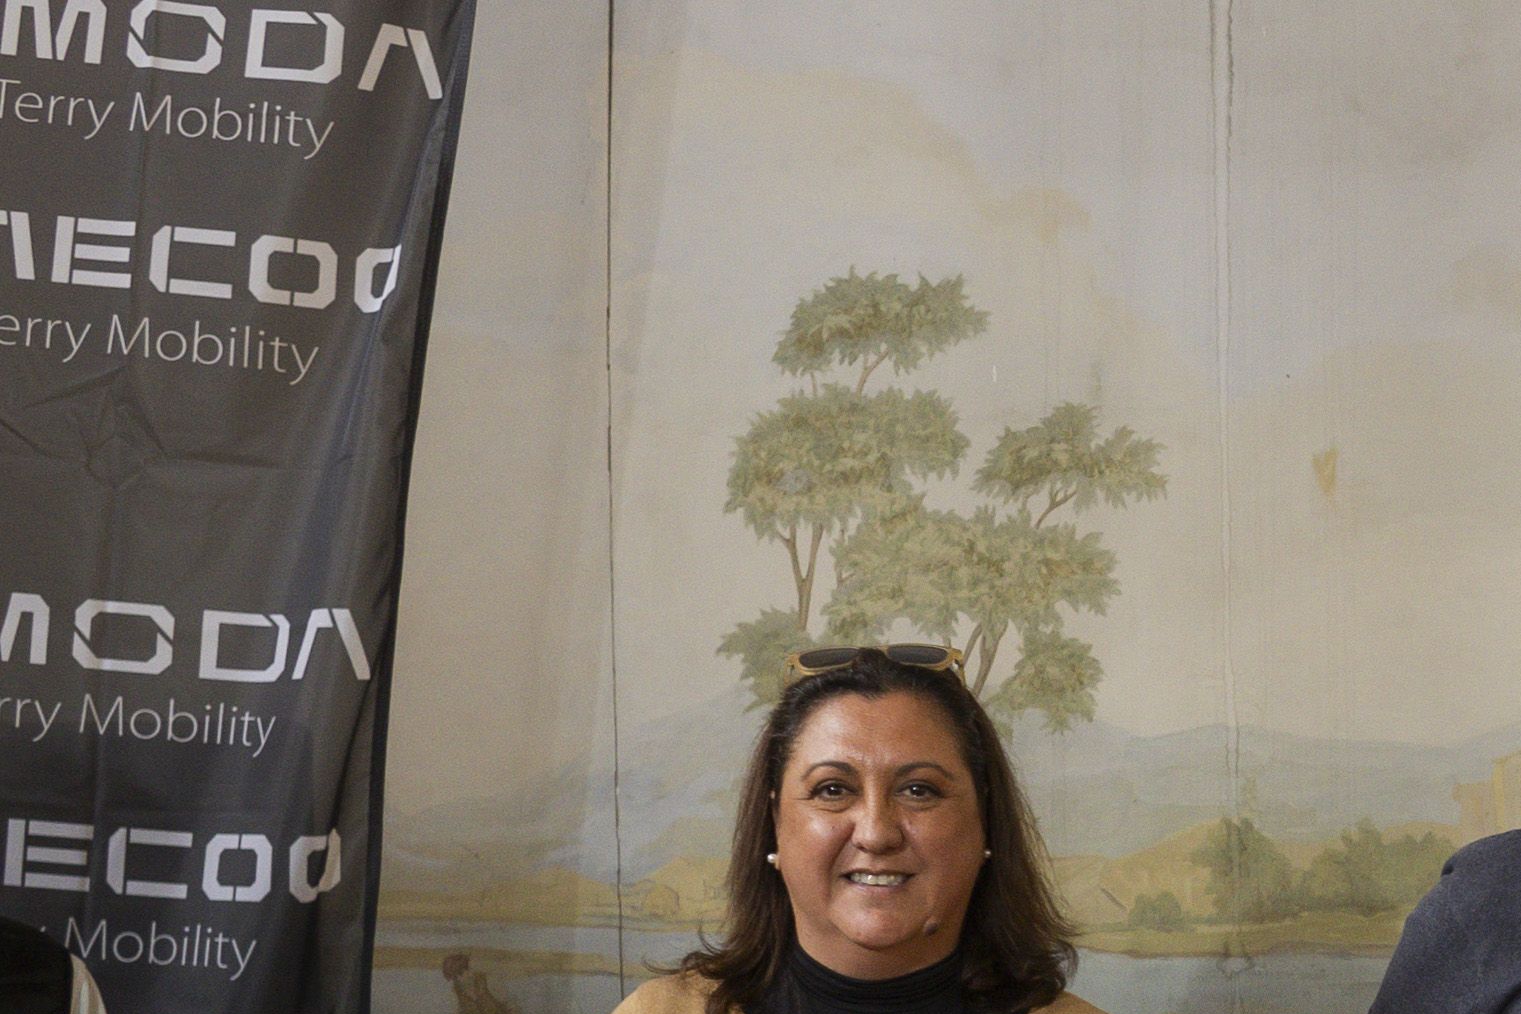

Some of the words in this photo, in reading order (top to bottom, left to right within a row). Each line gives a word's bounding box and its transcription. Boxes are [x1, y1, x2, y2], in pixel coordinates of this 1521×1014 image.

[129, 91, 334, 160] Mobility
[106, 314, 319, 386] Mobility
[79, 693, 277, 758] Mobility
[62, 916, 257, 981] Mobility
